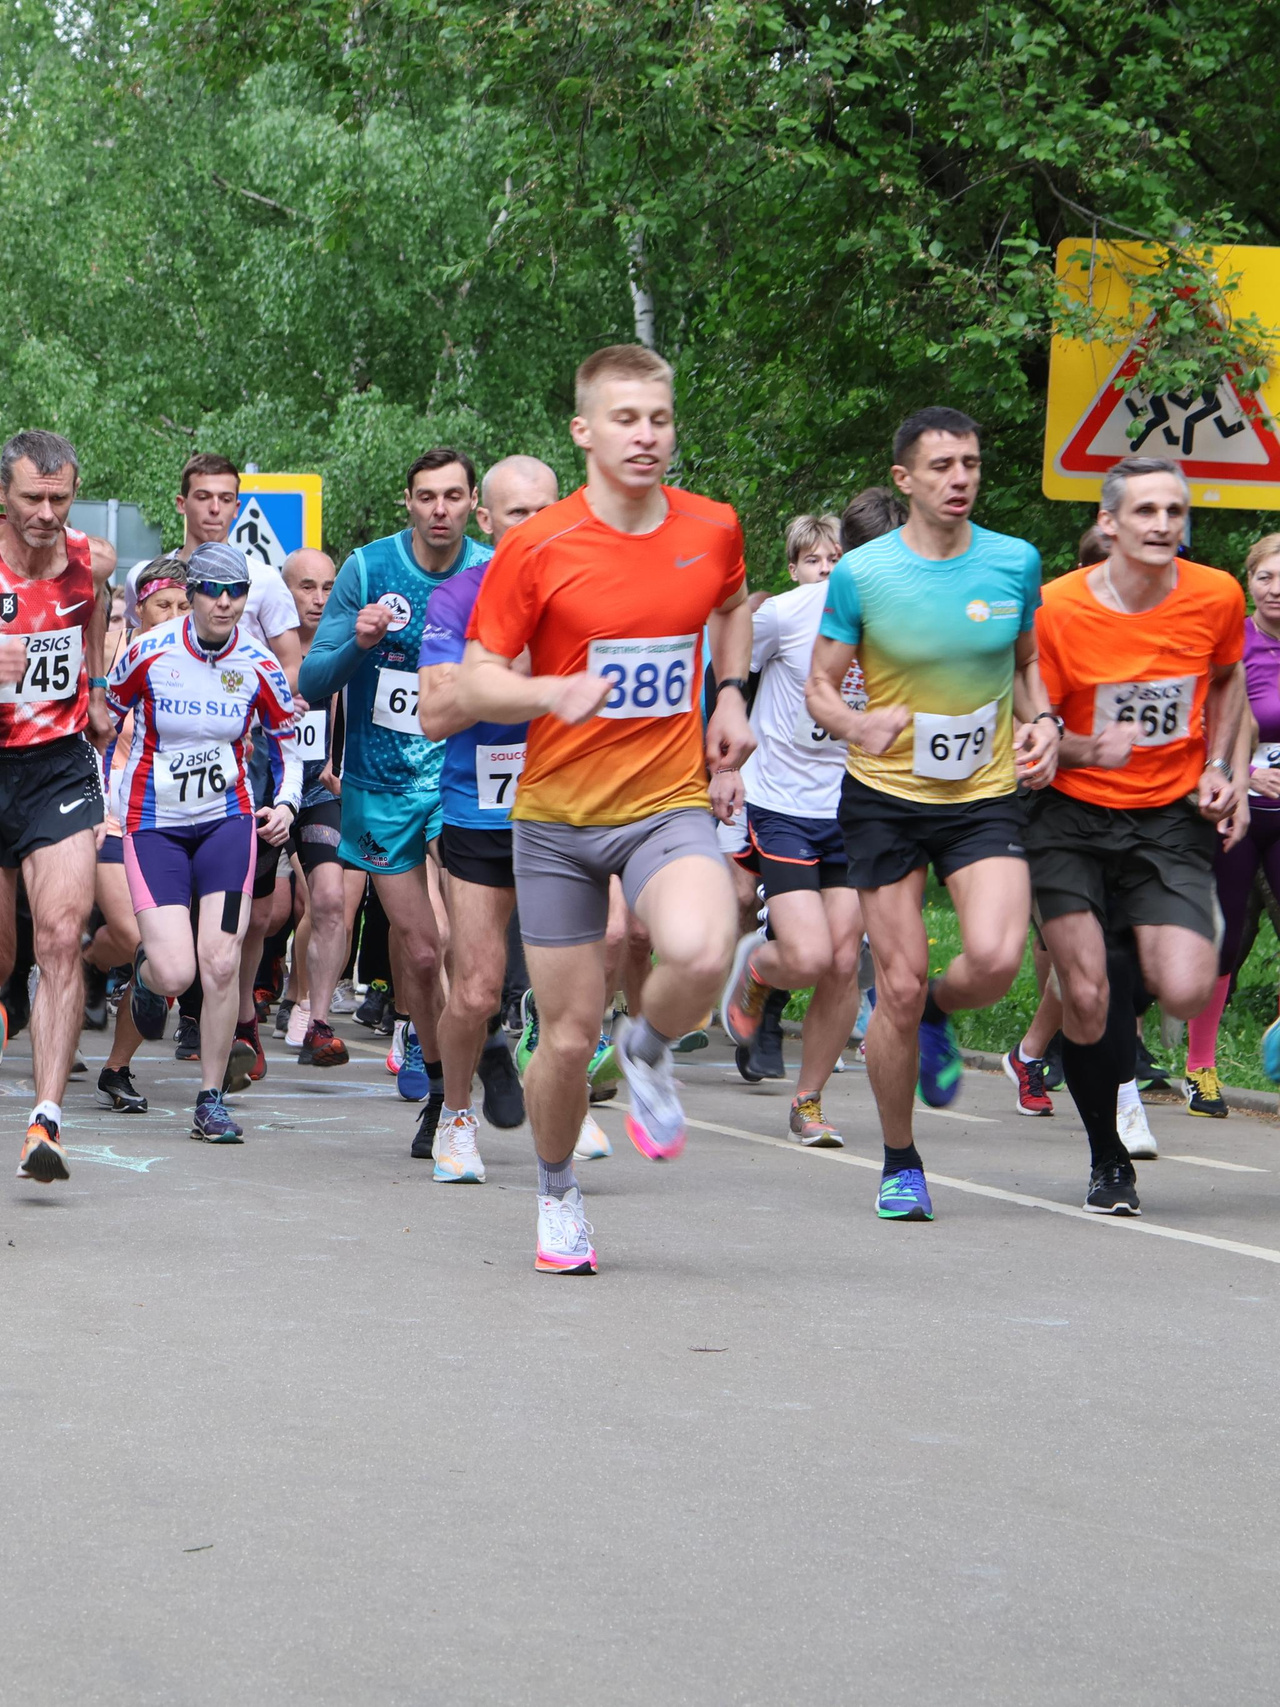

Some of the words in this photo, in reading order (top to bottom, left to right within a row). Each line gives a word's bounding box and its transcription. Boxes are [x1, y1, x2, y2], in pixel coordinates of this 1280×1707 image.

[15, 654, 70, 694] 745
[115, 632, 176, 681] ITERA
[238, 645, 292, 703] ITERA
[600, 659, 685, 709] 386
[930, 726, 986, 761] 679
[173, 764, 227, 802] 776
